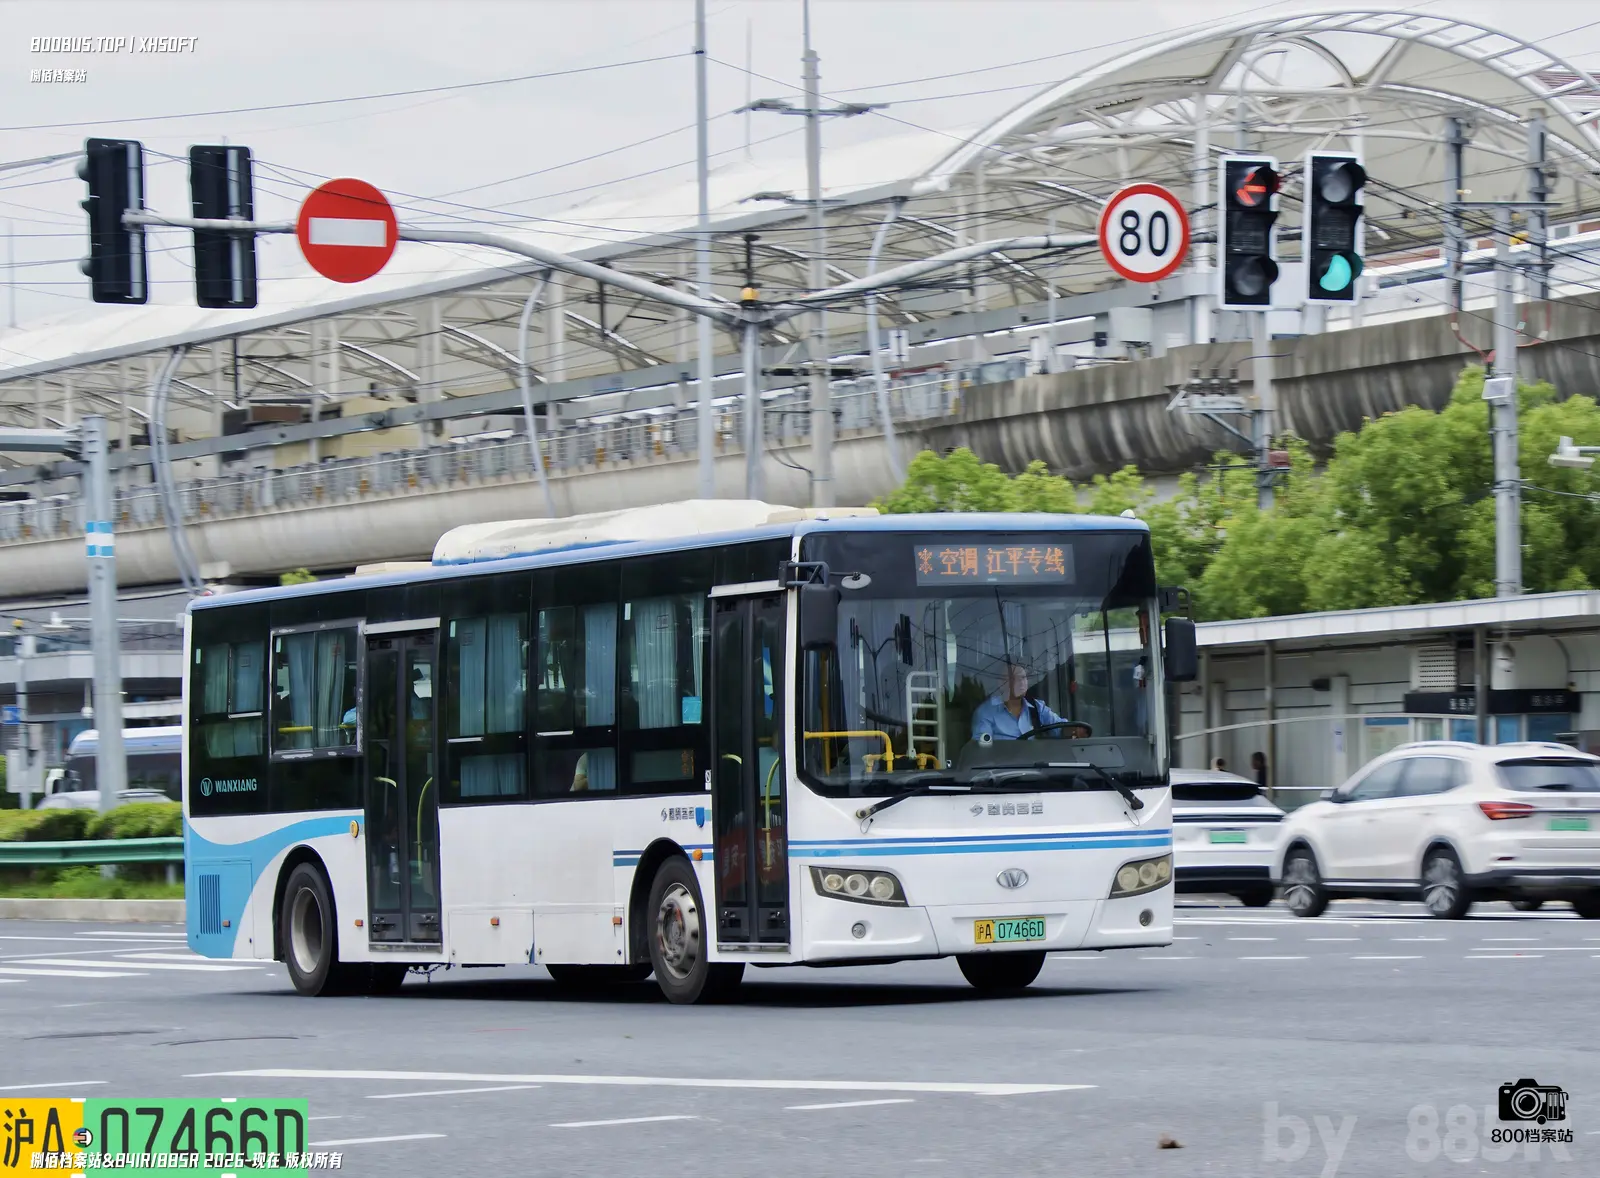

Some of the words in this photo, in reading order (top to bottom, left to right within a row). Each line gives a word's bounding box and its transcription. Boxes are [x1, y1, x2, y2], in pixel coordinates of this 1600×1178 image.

[1120, 210, 1169, 257] 80
[938, 547, 978, 576] 空调
[985, 547, 1065, 576] 江平专线
[214, 778, 258, 793] WANXIANG
[998, 921, 1044, 939] 07466D
